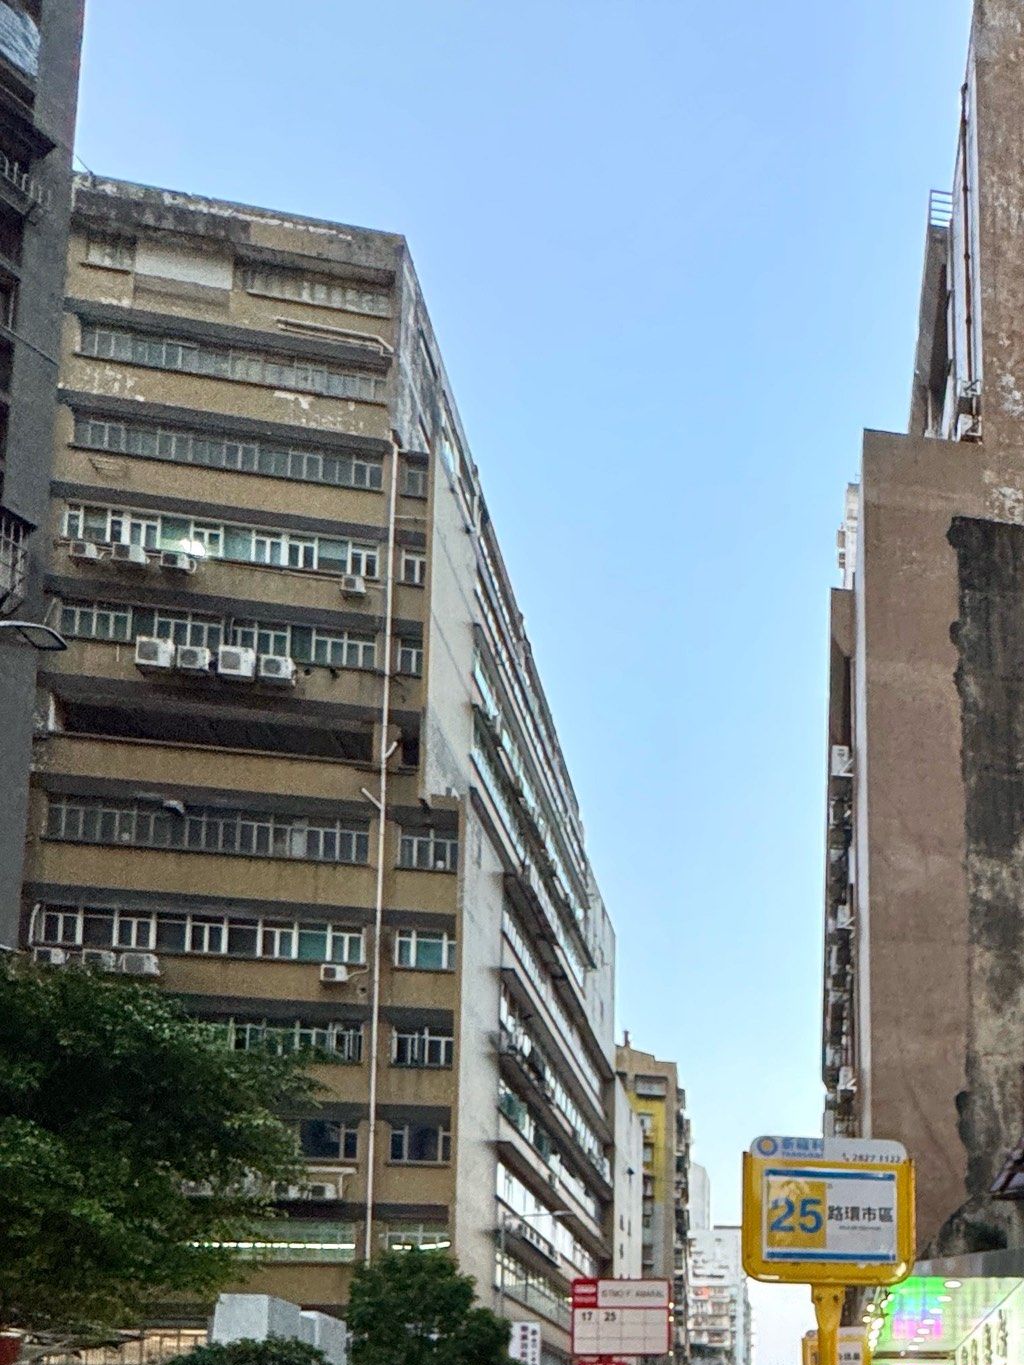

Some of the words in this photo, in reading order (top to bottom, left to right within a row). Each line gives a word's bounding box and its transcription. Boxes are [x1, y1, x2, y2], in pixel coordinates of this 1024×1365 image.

[770, 1197, 824, 1234] 25
[827, 1205, 894, 1223] 路環市區
[580, 1311, 593, 1322] 17
[603, 1311, 617, 1322] 25
